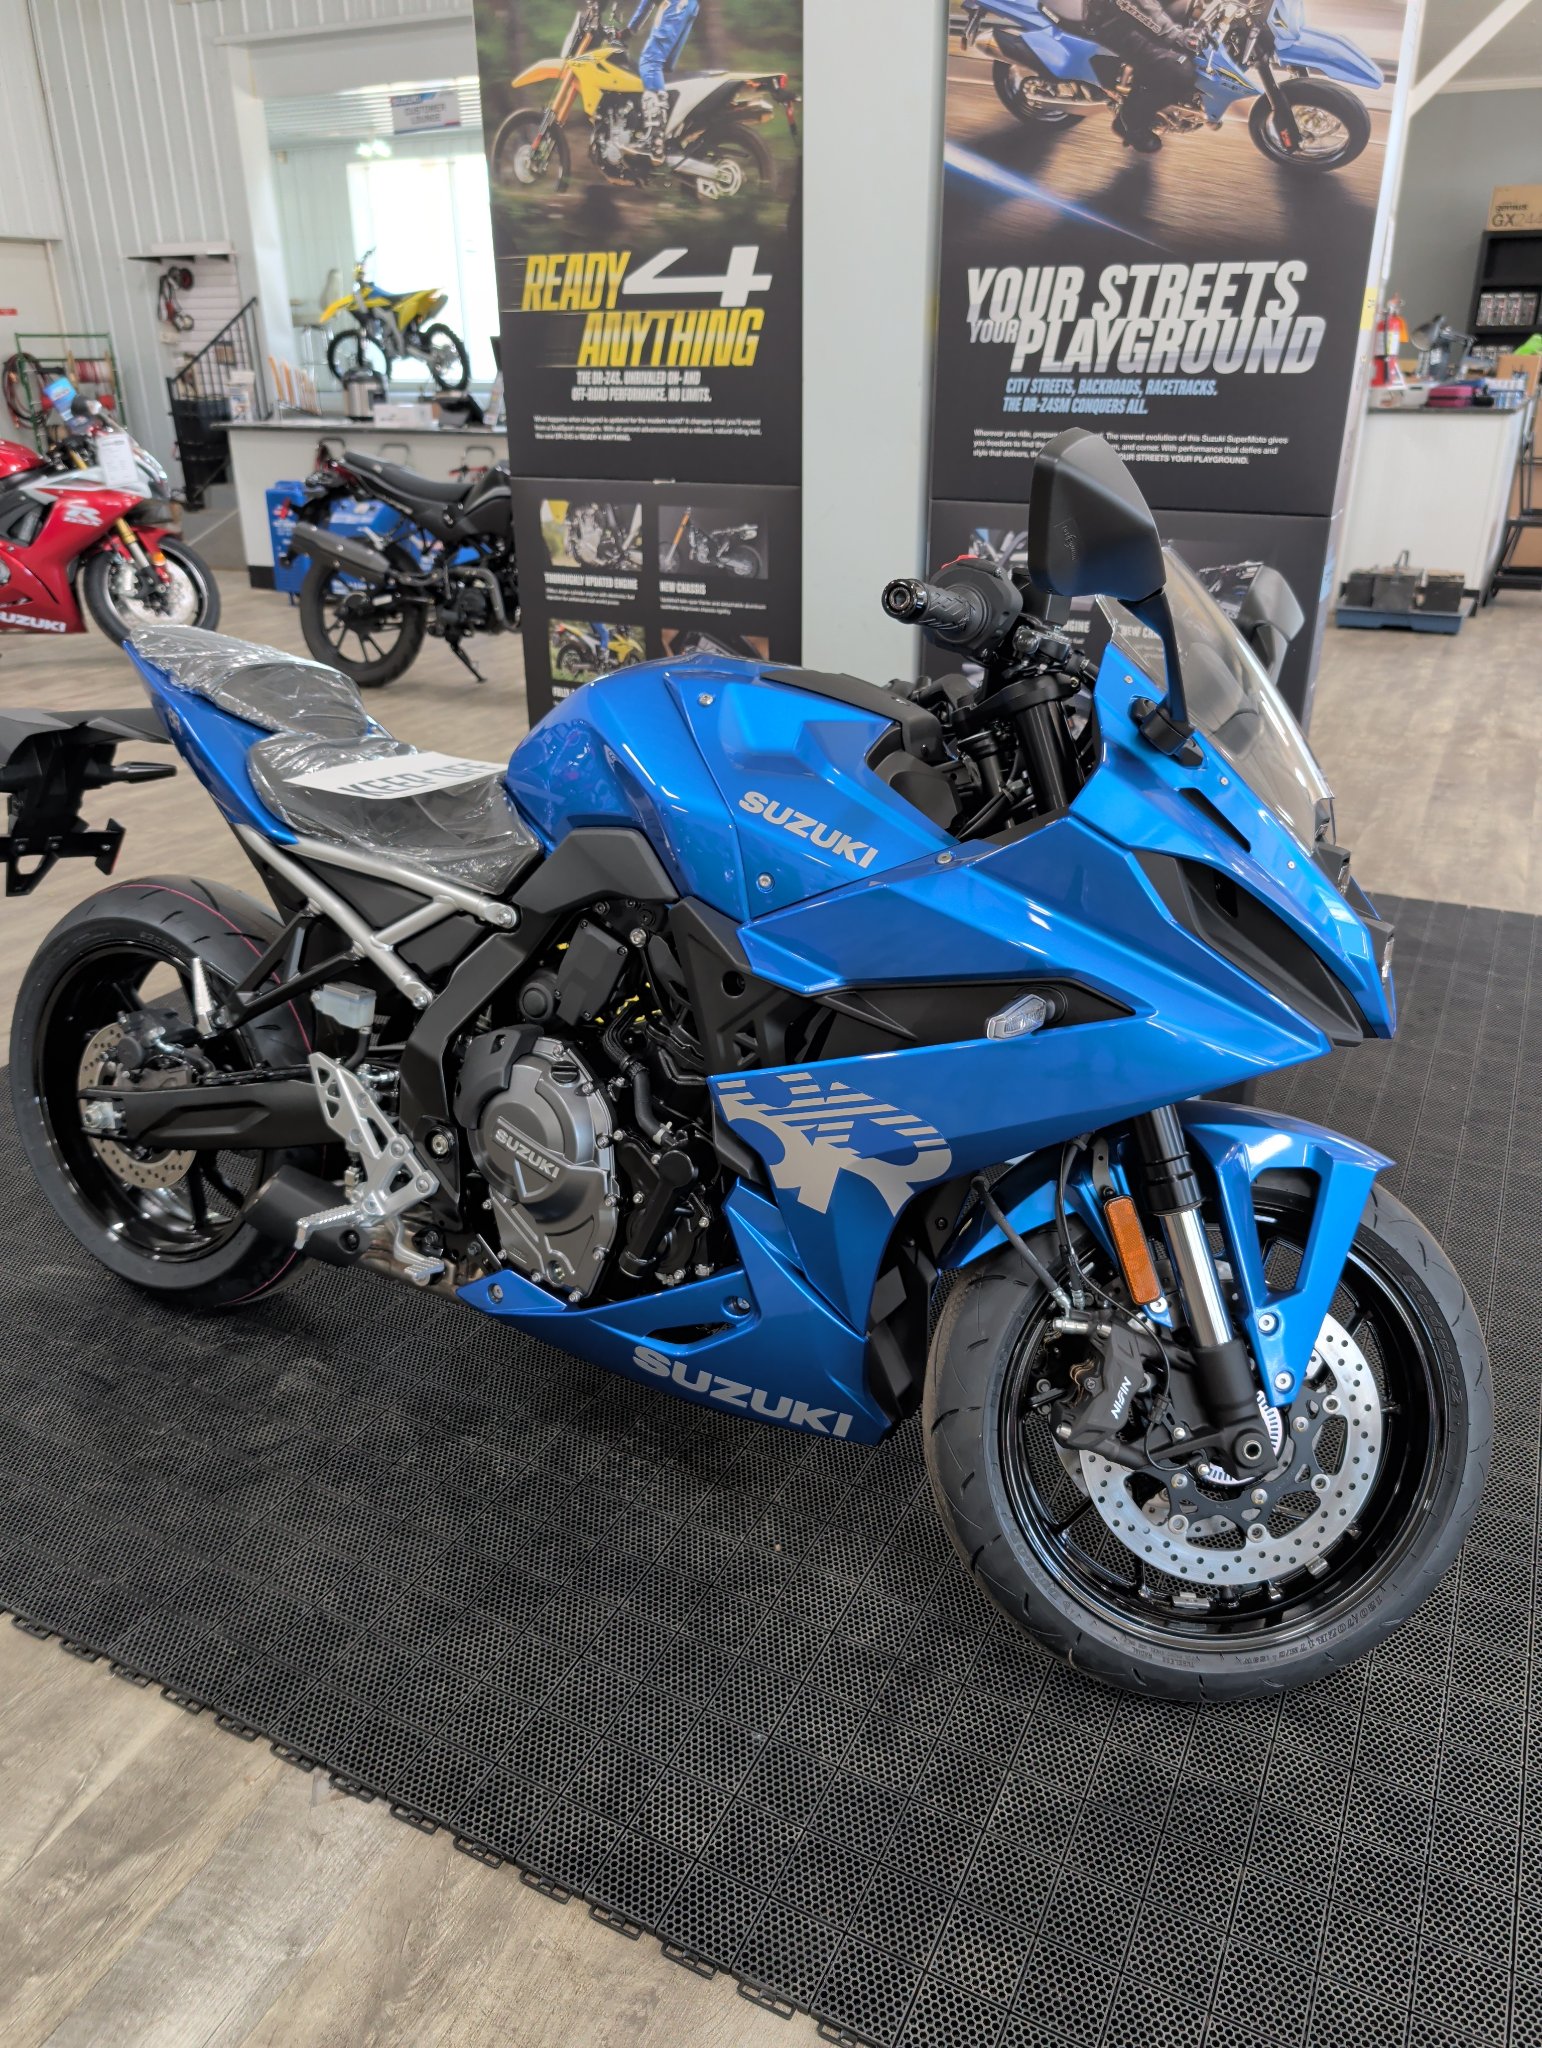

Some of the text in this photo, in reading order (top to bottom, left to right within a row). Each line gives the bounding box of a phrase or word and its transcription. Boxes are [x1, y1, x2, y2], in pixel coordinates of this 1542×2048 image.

[521, 246, 772, 312] READY 4
[967, 260, 1308, 323] YOUR STREETS
[577, 307, 765, 367] ANYTHING
[969, 316, 1326, 374] YOUR PLAYGROUND
[576, 370, 592, 385] THE
[624, 371, 667, 386] UNRIVALED
[667, 370, 682, 386] ON-
[682, 371, 701, 386] AND
[1005, 377, 1218, 398] CITY STREETS, BACKROADS, RACETRACKS.
[571, 386, 712, 402] OFF-ROAD PERFORMANCE. NO LIMITS.
[1003, 397, 1149, 415] THE DR-Z4SM CONQUERS ALL.
[1105, 431, 1119, 440] The
[1119, 432, 1145, 441] newest
[1145, 433, 1177, 442] evolution
[1178, 433, 1187, 442] of
[1187, 434, 1201, 443] this
[1201, 434, 1225, 443] Suzuki
[1226, 435, 1267, 445] SuperMoto
[1267, 437, 1289, 446] gives
[1121, 444, 1135, 452] and
[1135, 444, 1160, 453] corner.
[1161, 444, 1178, 453] With
[1178, 445, 1223, 455] performance
[1224, 446, 1239, 455] that
[1239, 447, 1263, 455] defies
[1263, 447, 1279, 456] and
[1136, 454, 1170, 463] STREETS
[1170, 454, 1194, 463] YOUR
[1194, 455, 1250, 466] PLAYGROUND.
[659, 580, 707, 596] NEW CHASSIS
[0, 611, 67, 633] UZUKI
[337, 761, 500, 797] KEEP OFF
[738, 791, 879, 869] SUZUKI
[495, 1128, 561, 1179] SUZUKI
[632, 1345, 853, 1438] SUZUKI
